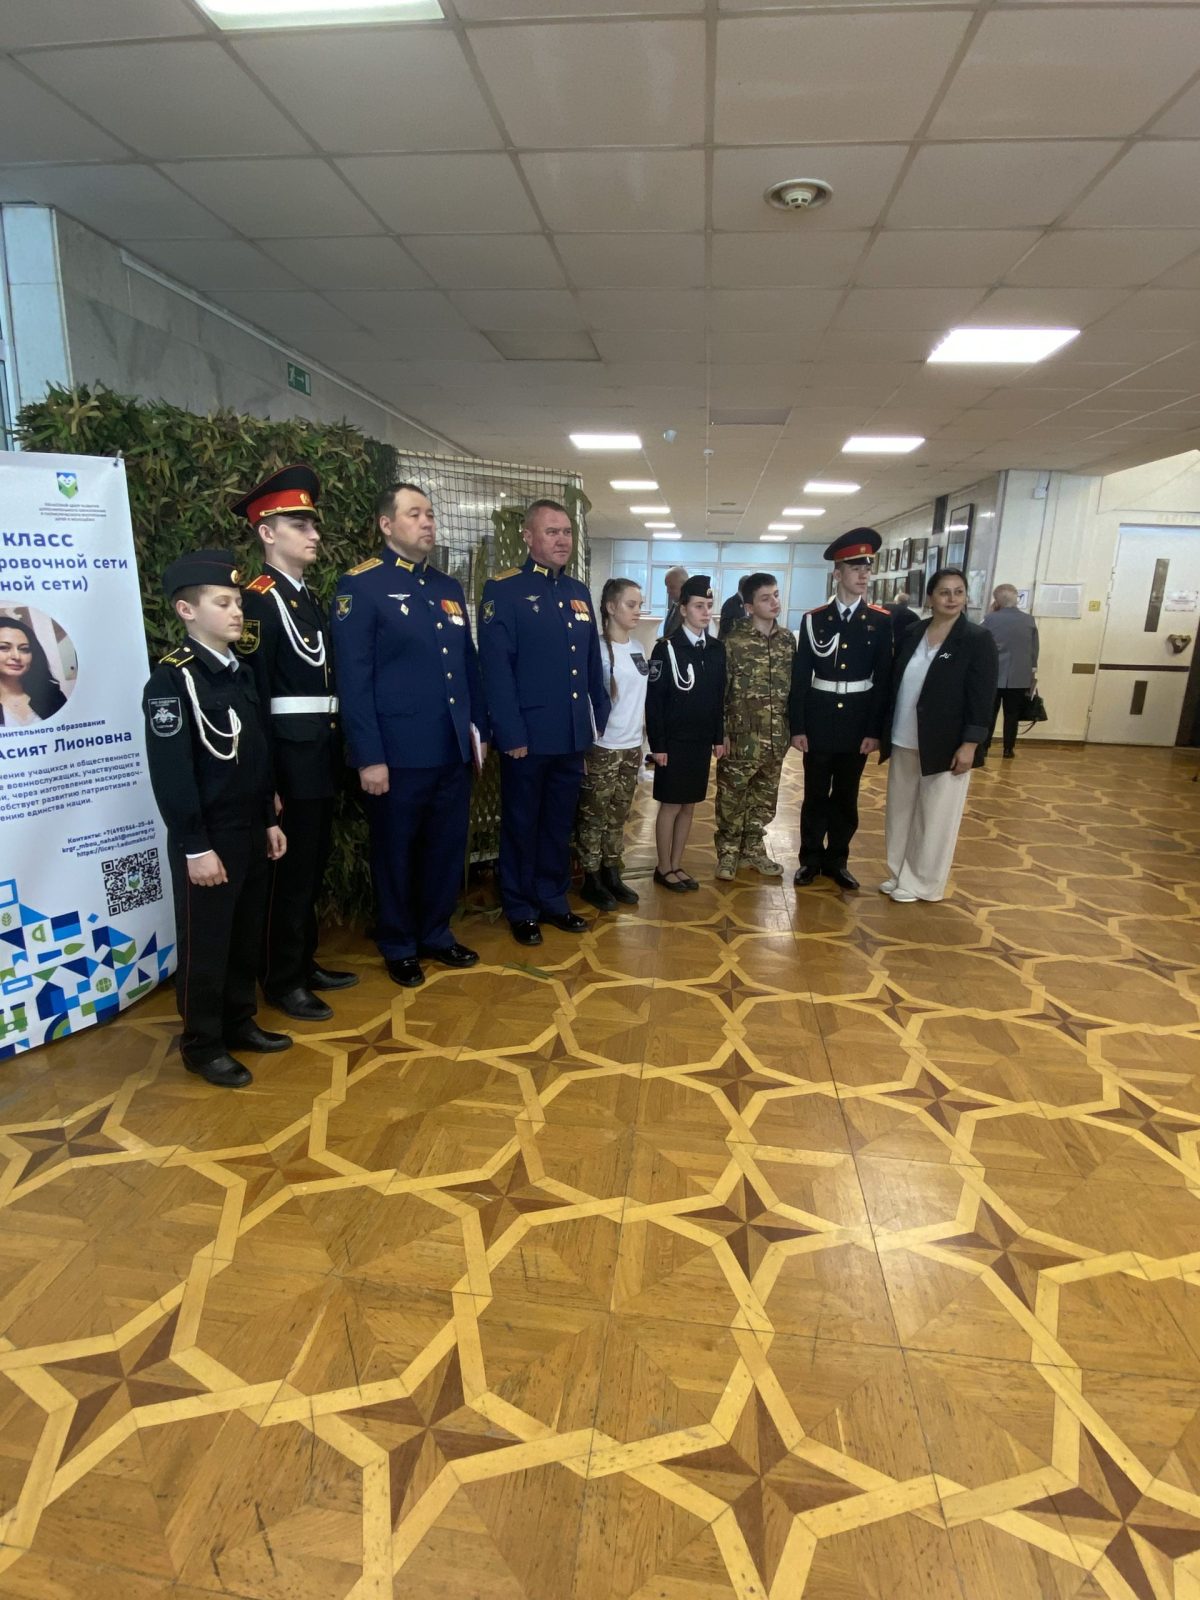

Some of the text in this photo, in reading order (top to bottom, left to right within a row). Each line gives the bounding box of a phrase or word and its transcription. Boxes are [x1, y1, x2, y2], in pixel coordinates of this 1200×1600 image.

[3, 532, 74, 547] класс
[93, 558, 128, 569] сети
[0, 575, 89, 592] ной сети)
[56, 720, 106, 732] образования
[54, 731, 132, 753] Лионовна
[28, 764, 68, 777] учащихся
[76, 752, 140, 768] общественности
[83, 762, 134, 777] участвующих
[12, 790, 38, 800] через
[40, 778, 93, 794] изготовление
[42, 791, 80, 805] развитию
[81, 781, 131, 797] патриотизма
[27, 804, 65, 817] единства
[67, 832, 102, 844] Контакты:
